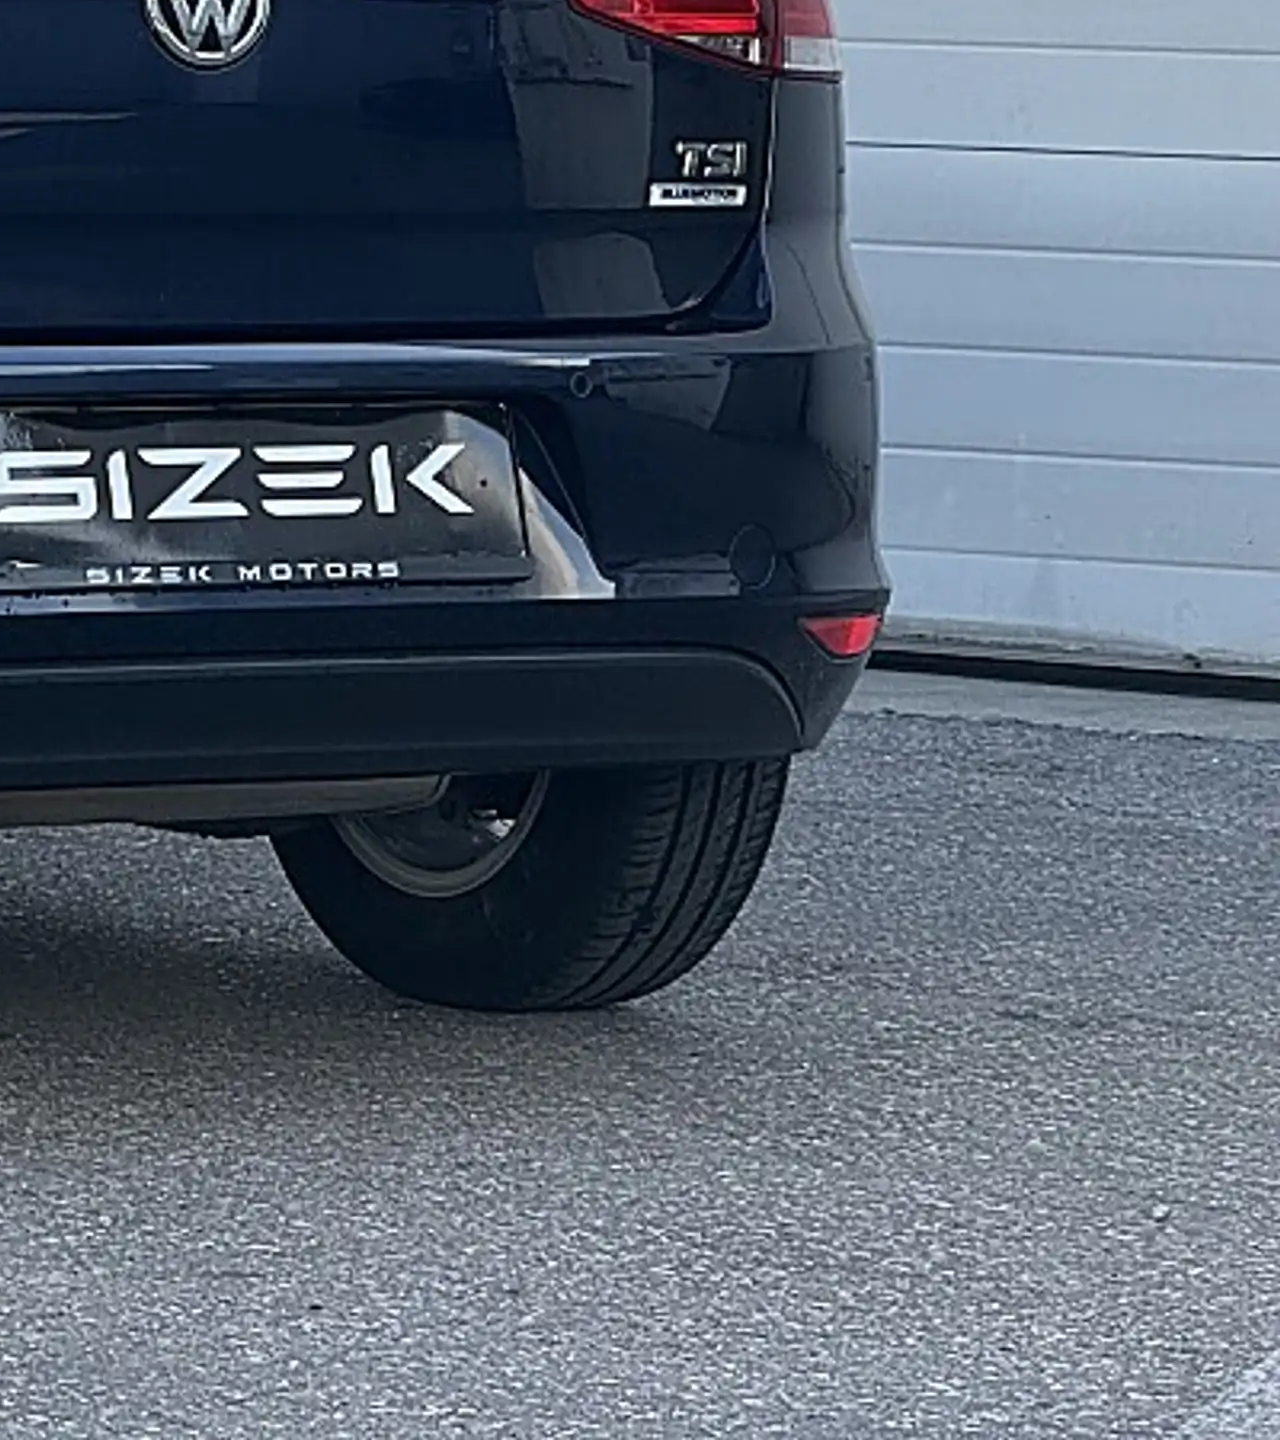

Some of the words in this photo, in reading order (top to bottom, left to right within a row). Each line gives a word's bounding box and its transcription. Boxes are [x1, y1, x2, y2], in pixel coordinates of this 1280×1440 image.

[675, 141, 746, 177] TSI
[86, 565, 212, 585] SIZEK
[238, 561, 400, 581] MOTORS
